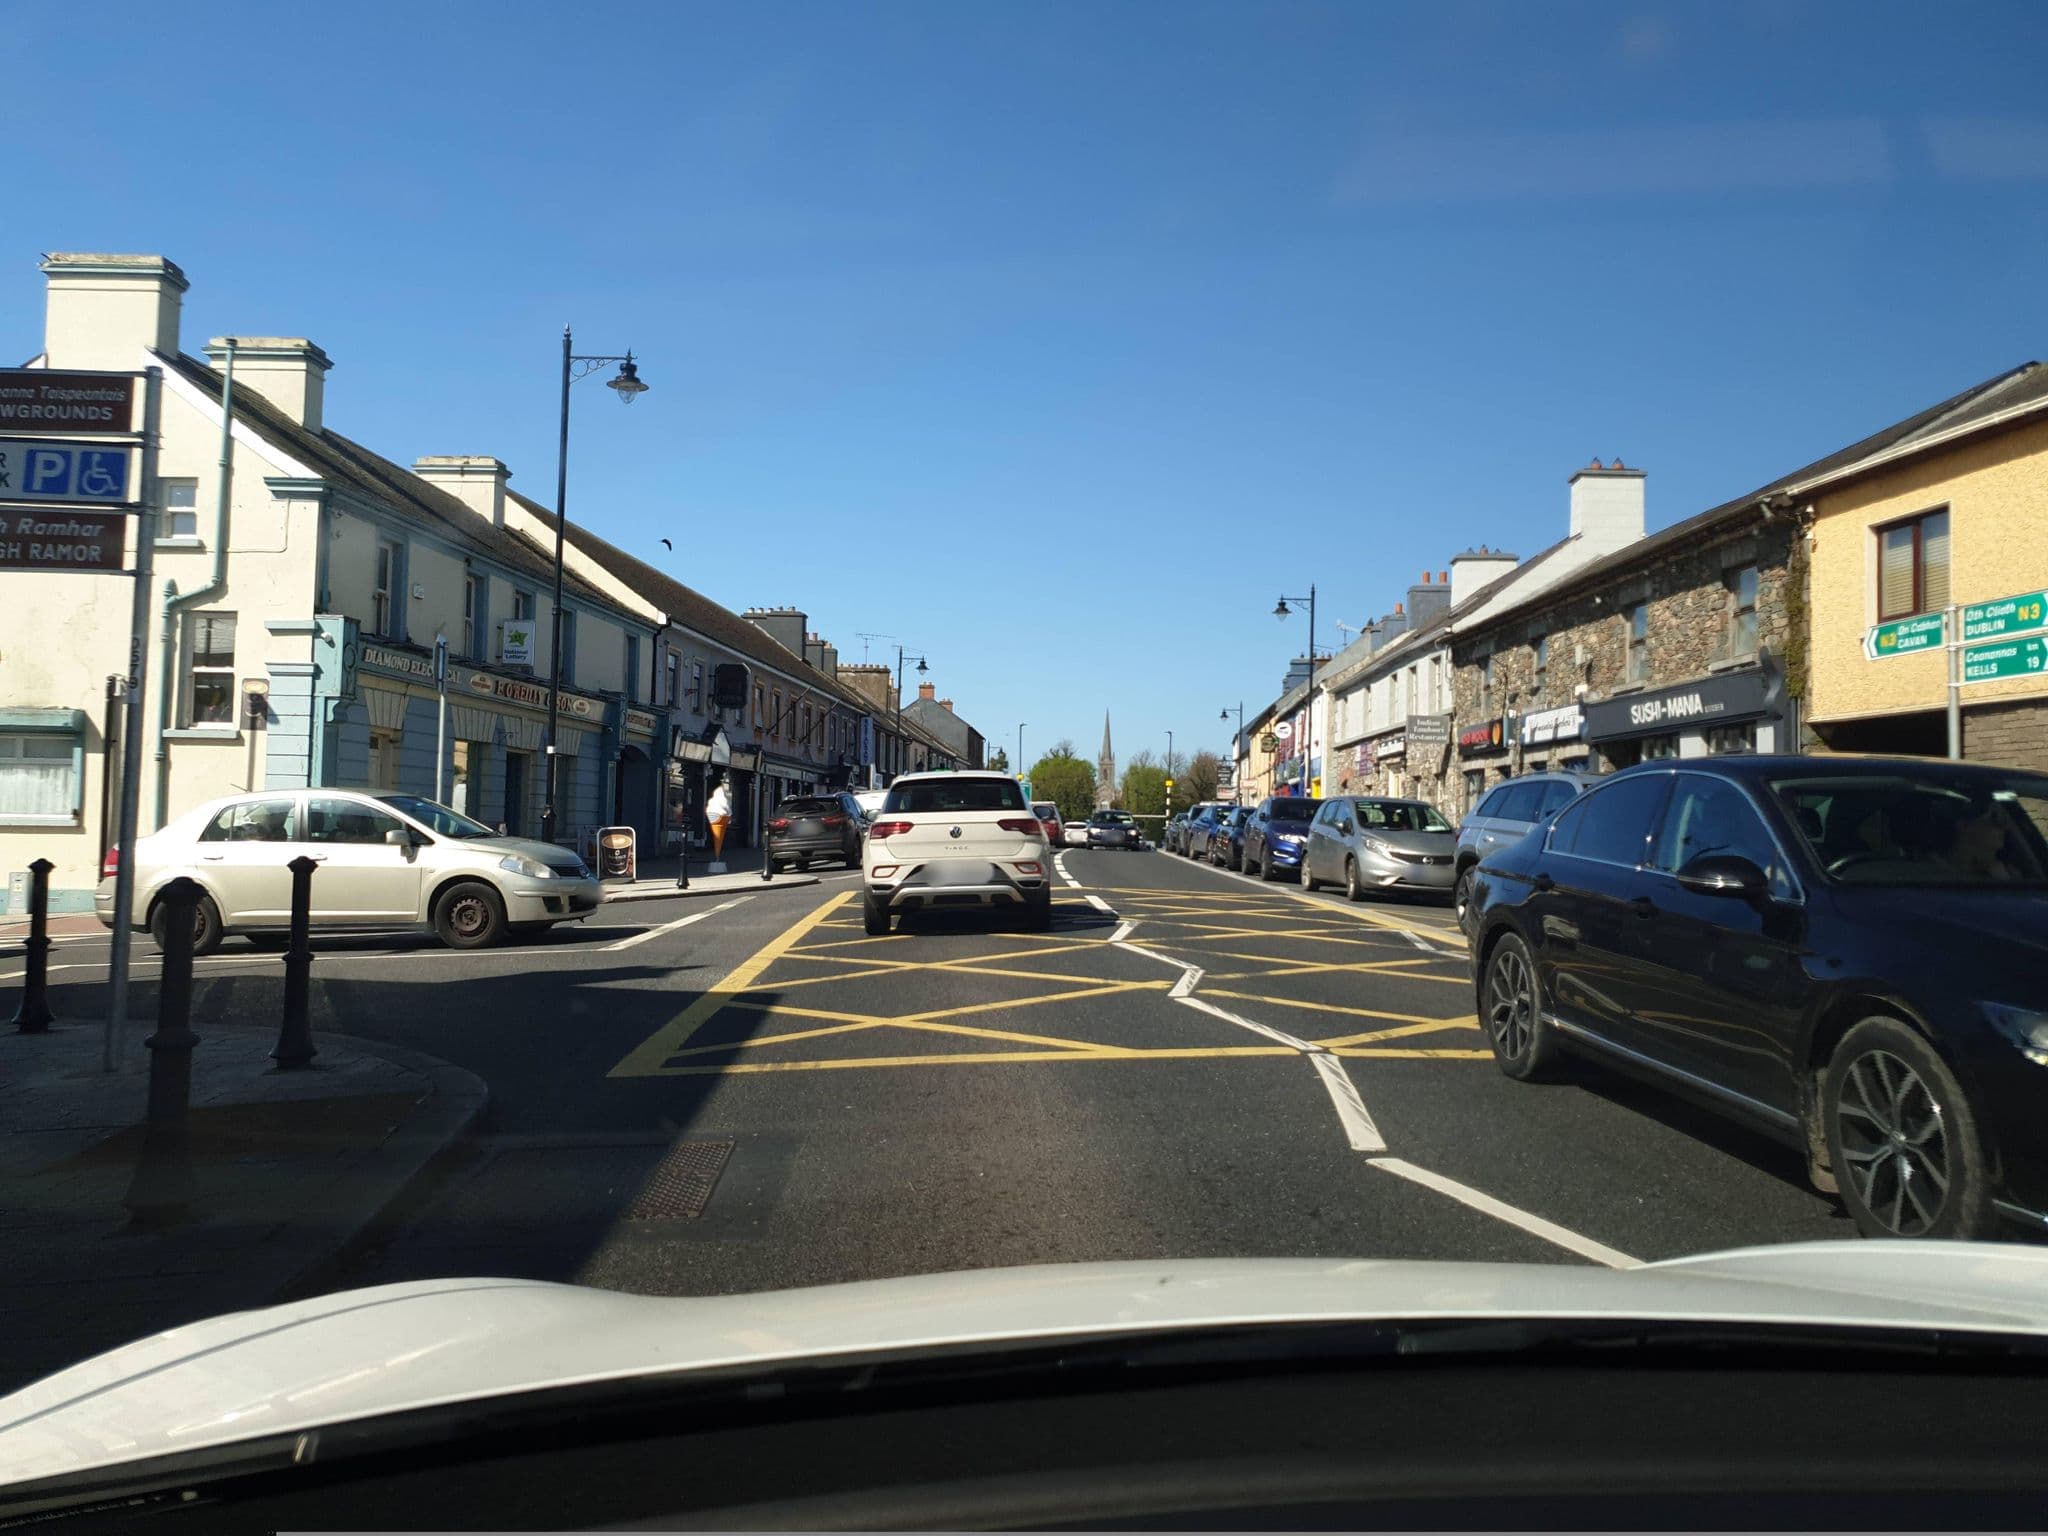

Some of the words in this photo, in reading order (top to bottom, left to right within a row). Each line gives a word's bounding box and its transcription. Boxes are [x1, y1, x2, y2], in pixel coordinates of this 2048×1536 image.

[16, 517, 105, 537] Ramhar
[29, 542, 102, 562] RAMOR
[2018, 603, 2041, 622] N3
[1966, 619, 2006, 636] DUBLIN
[1897, 634, 1928, 649] CAVAN
[364, 648, 410, 672] DIAMOND
[1966, 662, 1998, 677] KELLS
[2026, 655, 2040, 669] 19
[1631, 693, 1704, 725] SUSHI-MANIA
